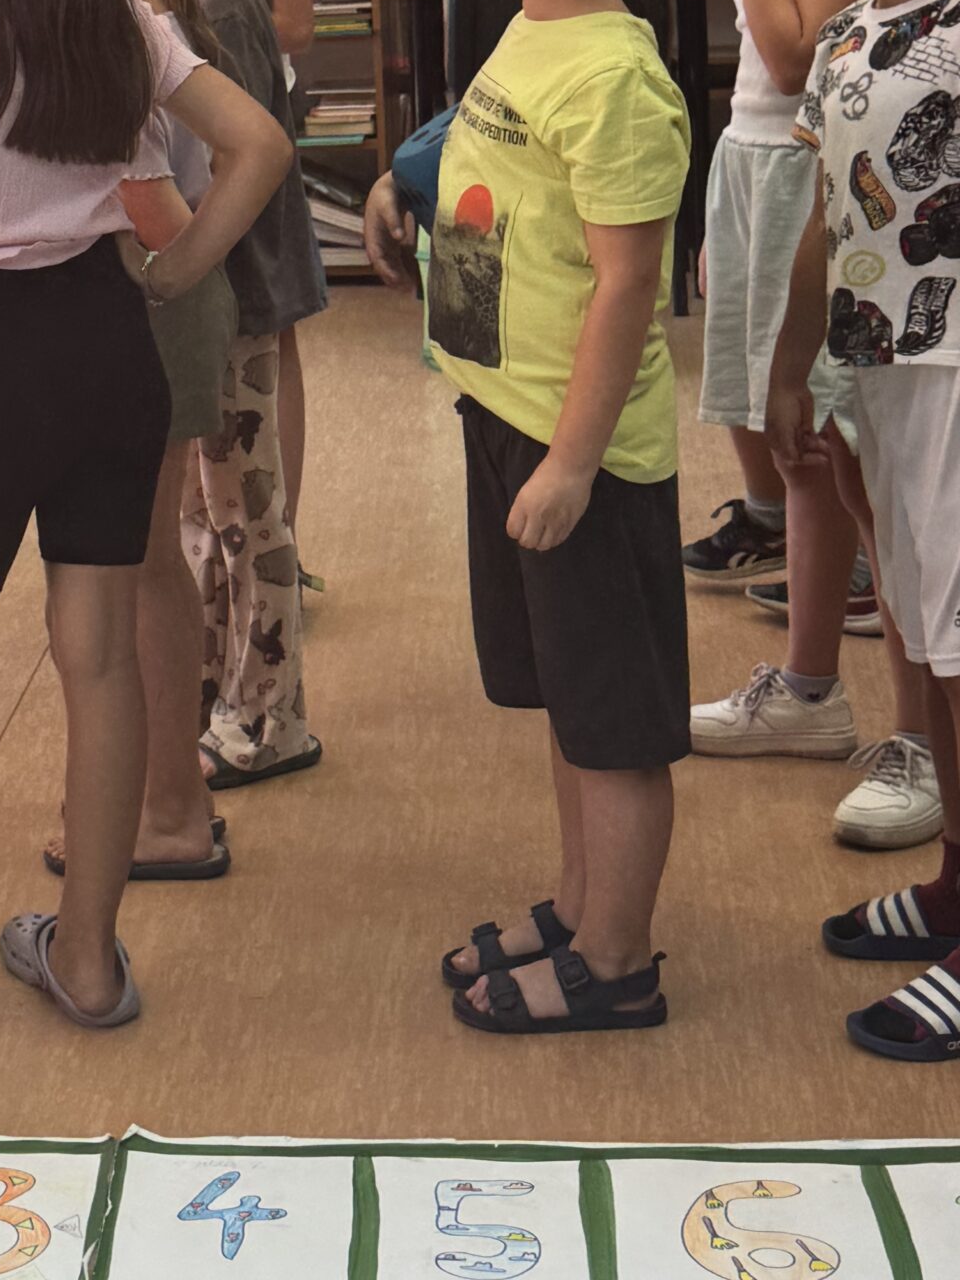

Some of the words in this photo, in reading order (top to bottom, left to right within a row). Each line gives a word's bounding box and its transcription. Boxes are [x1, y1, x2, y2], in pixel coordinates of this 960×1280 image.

[502, 105, 528, 125] WIL
[177, 1171, 287, 1260] 4
[435, 1179, 541, 1280] 5
[681, 1179, 841, 1280] 6
